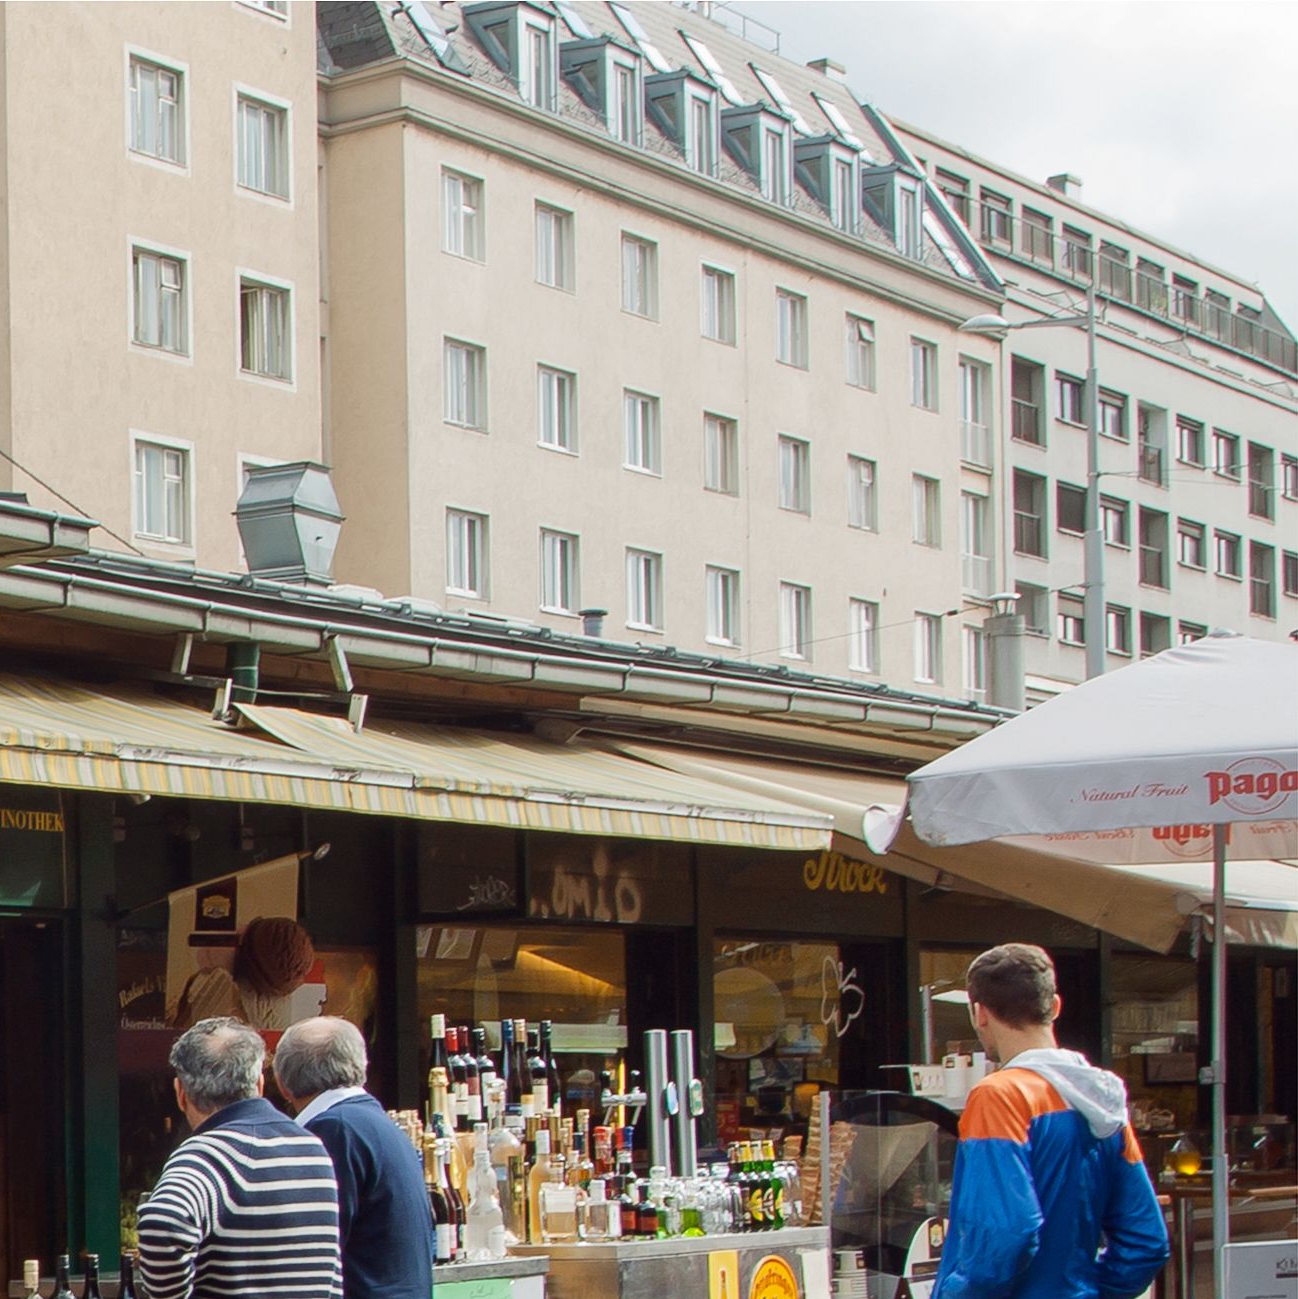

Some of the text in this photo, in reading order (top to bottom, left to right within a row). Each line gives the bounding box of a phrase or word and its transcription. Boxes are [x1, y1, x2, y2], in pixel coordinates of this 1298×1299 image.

[1071, 783, 1189, 803] Natural Fruit
[1203, 770, 1298, 806] pago
